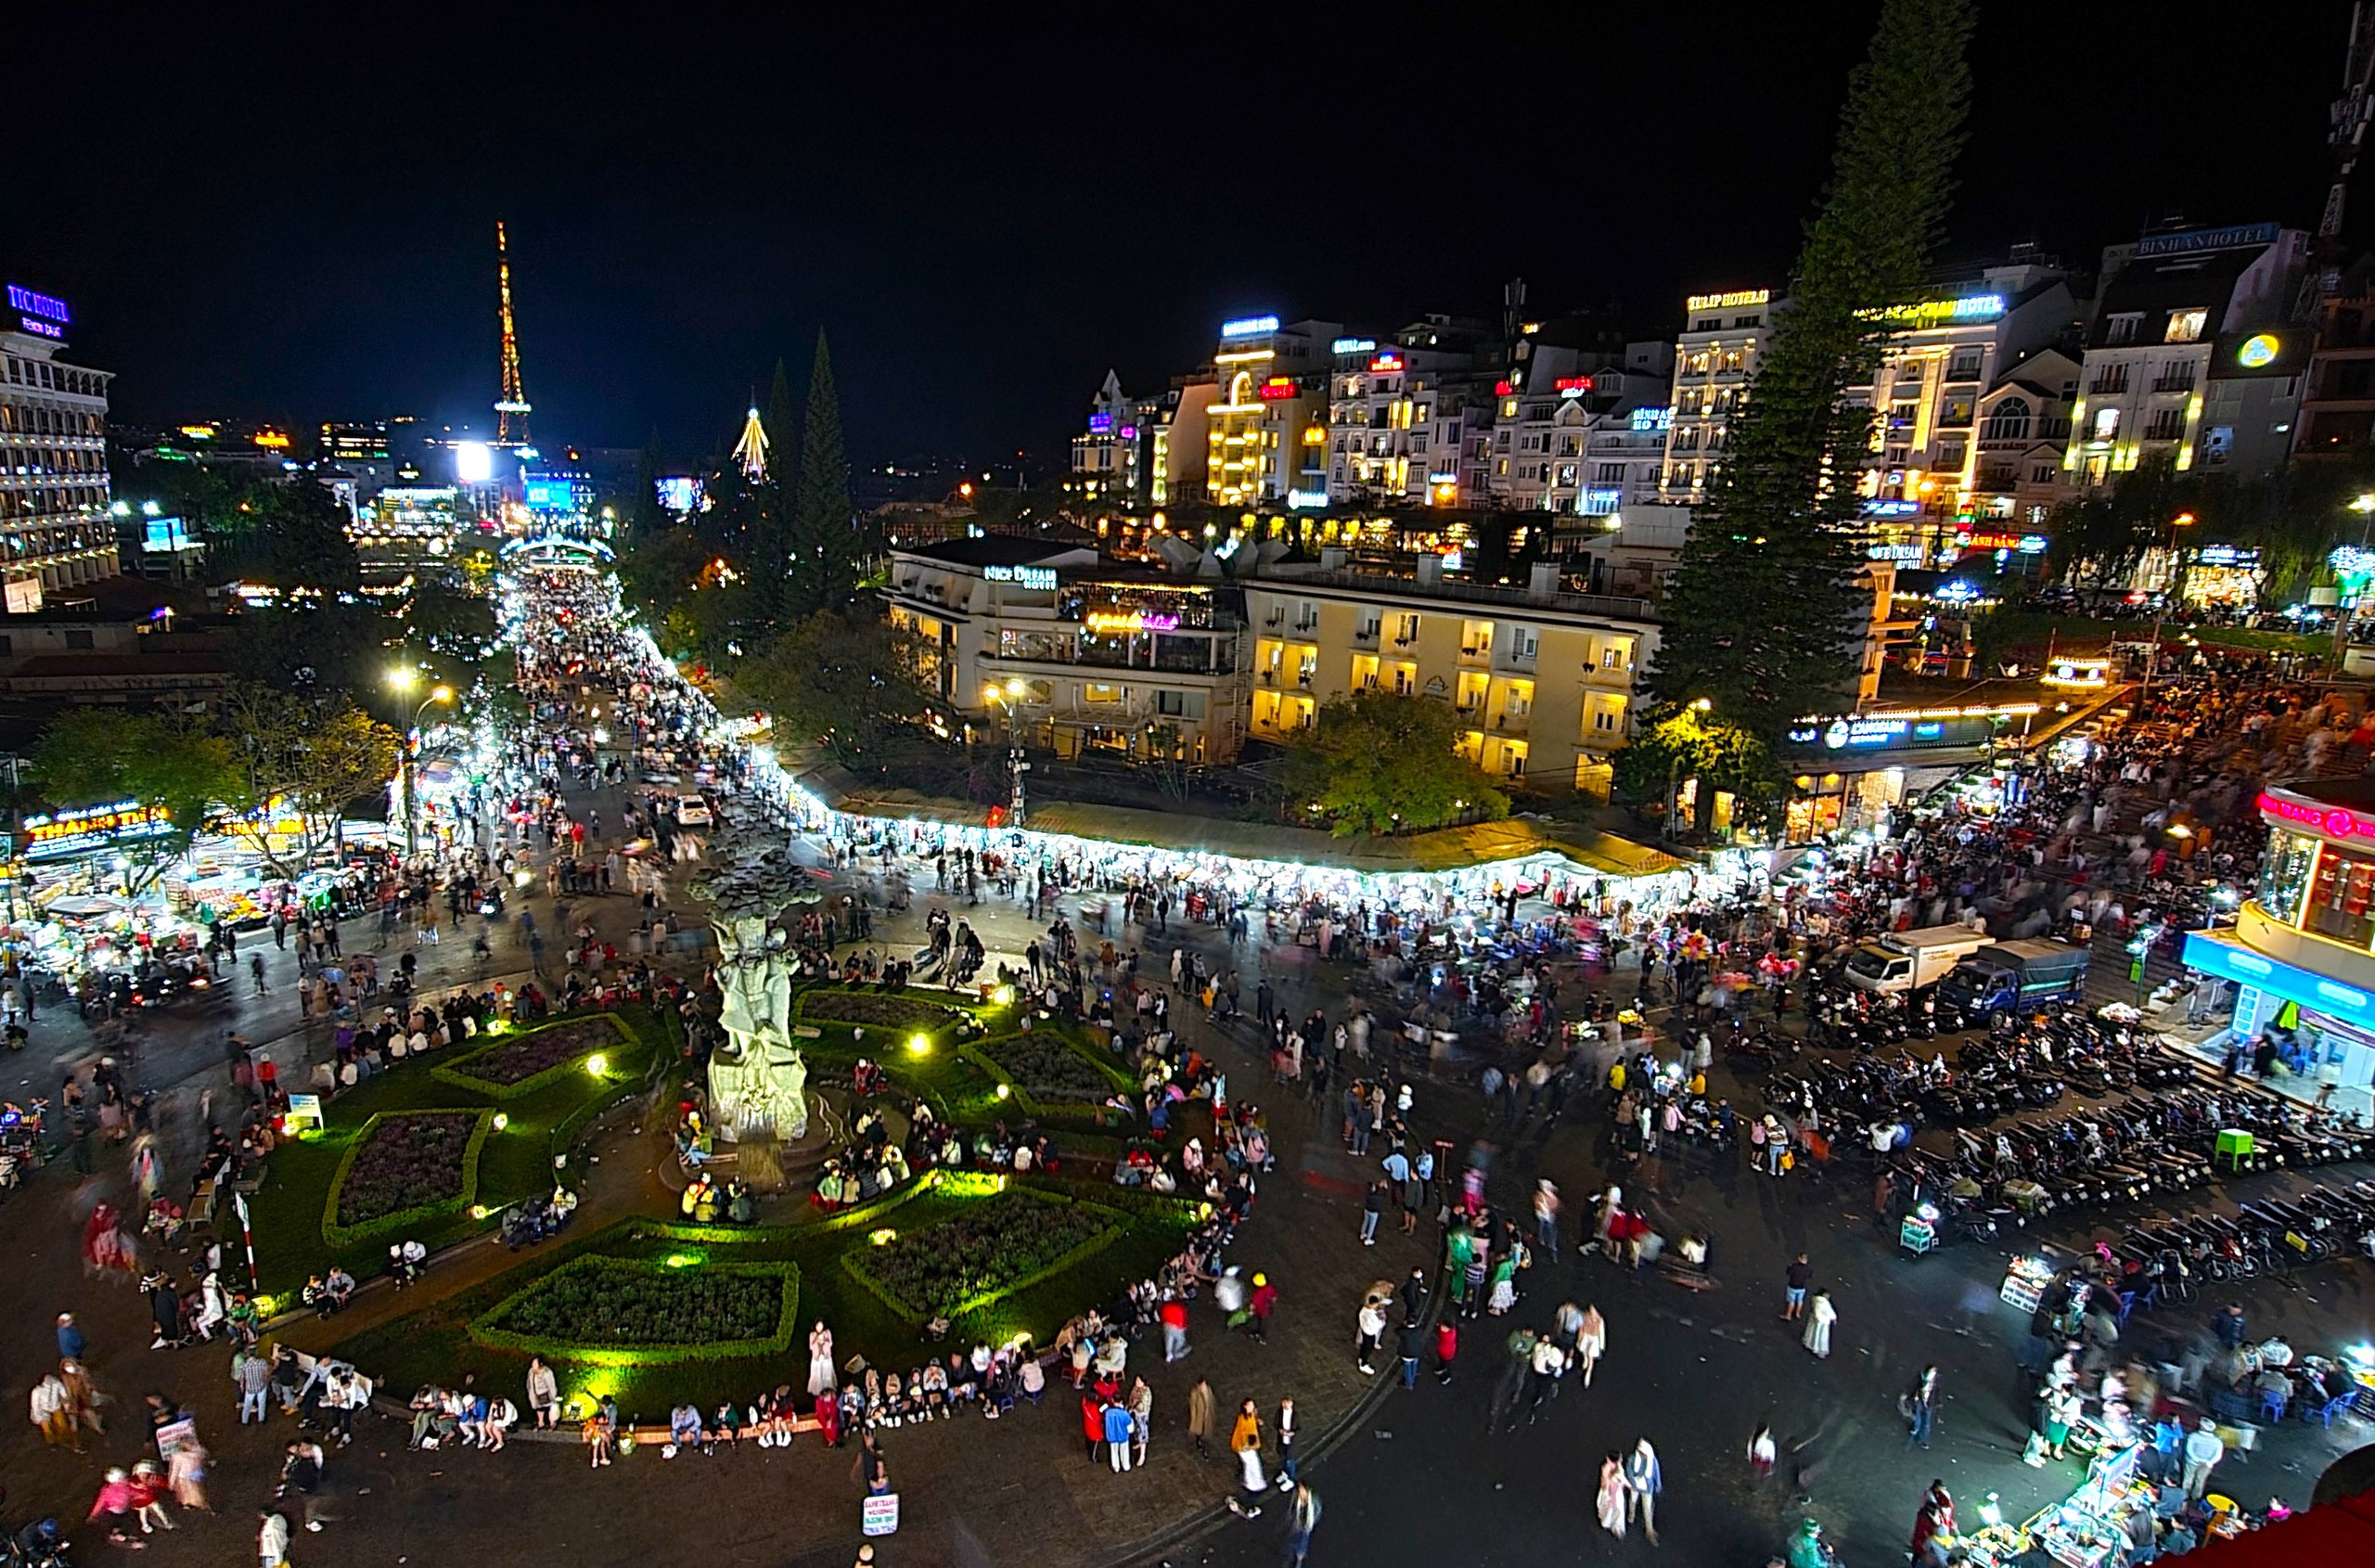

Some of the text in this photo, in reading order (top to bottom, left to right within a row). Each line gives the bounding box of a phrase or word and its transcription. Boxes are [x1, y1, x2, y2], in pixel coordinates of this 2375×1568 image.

[2208, 228, 2268, 246] HOTEL
[1688, 294, 1722, 311] TULIP
[1721, 290, 1757, 306] HOTEL
[1956, 294, 2006, 316] HOTEL
[1892, 544, 1923, 559] DREAM
[984, 564, 1057, 583] NICE DREAM
